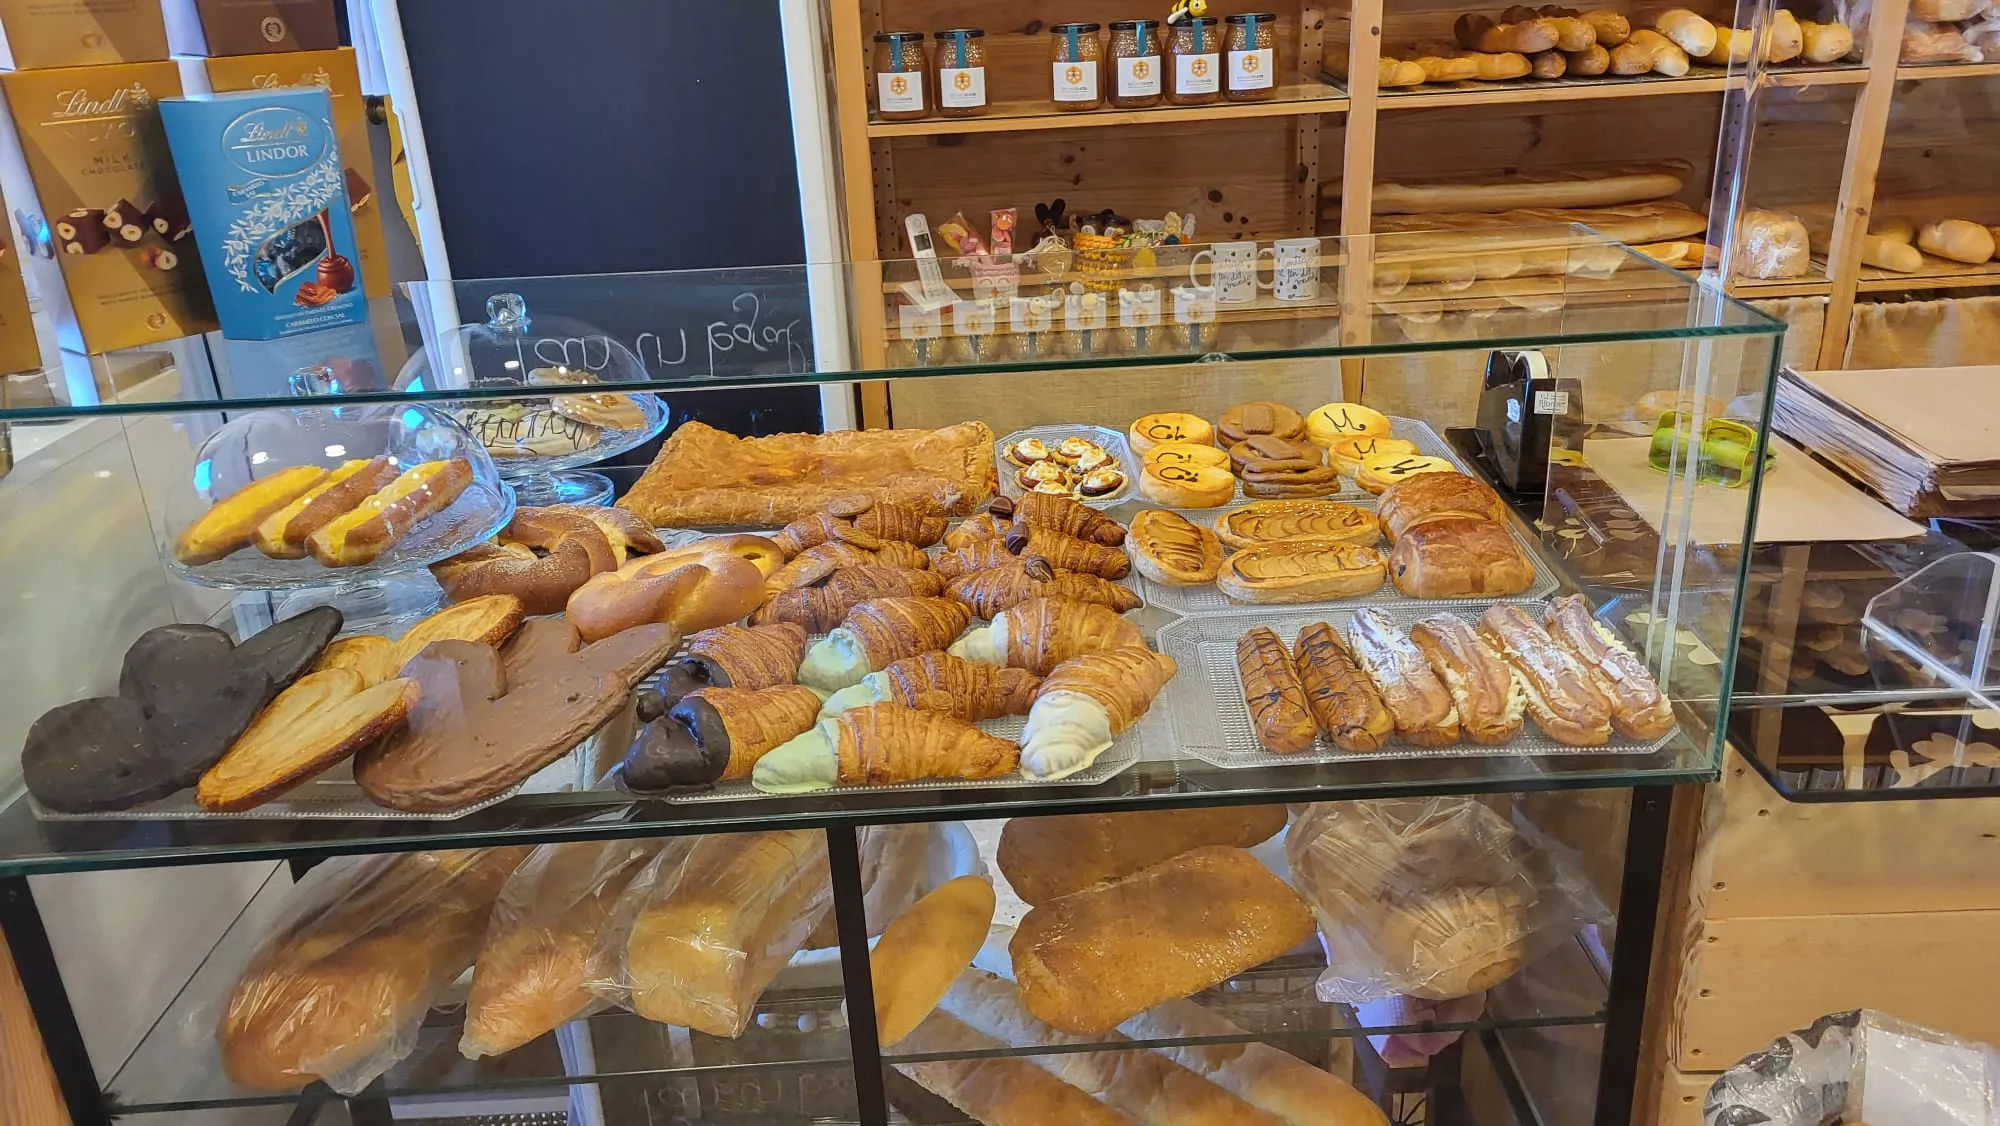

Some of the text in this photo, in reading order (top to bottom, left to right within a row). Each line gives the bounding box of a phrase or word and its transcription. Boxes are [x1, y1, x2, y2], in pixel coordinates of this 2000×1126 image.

[52, 88, 128, 117] Lindt
[240, 121, 293, 142] Lindt
[93, 152, 129, 165] MILK
[246, 145, 309, 163] LINDOR
